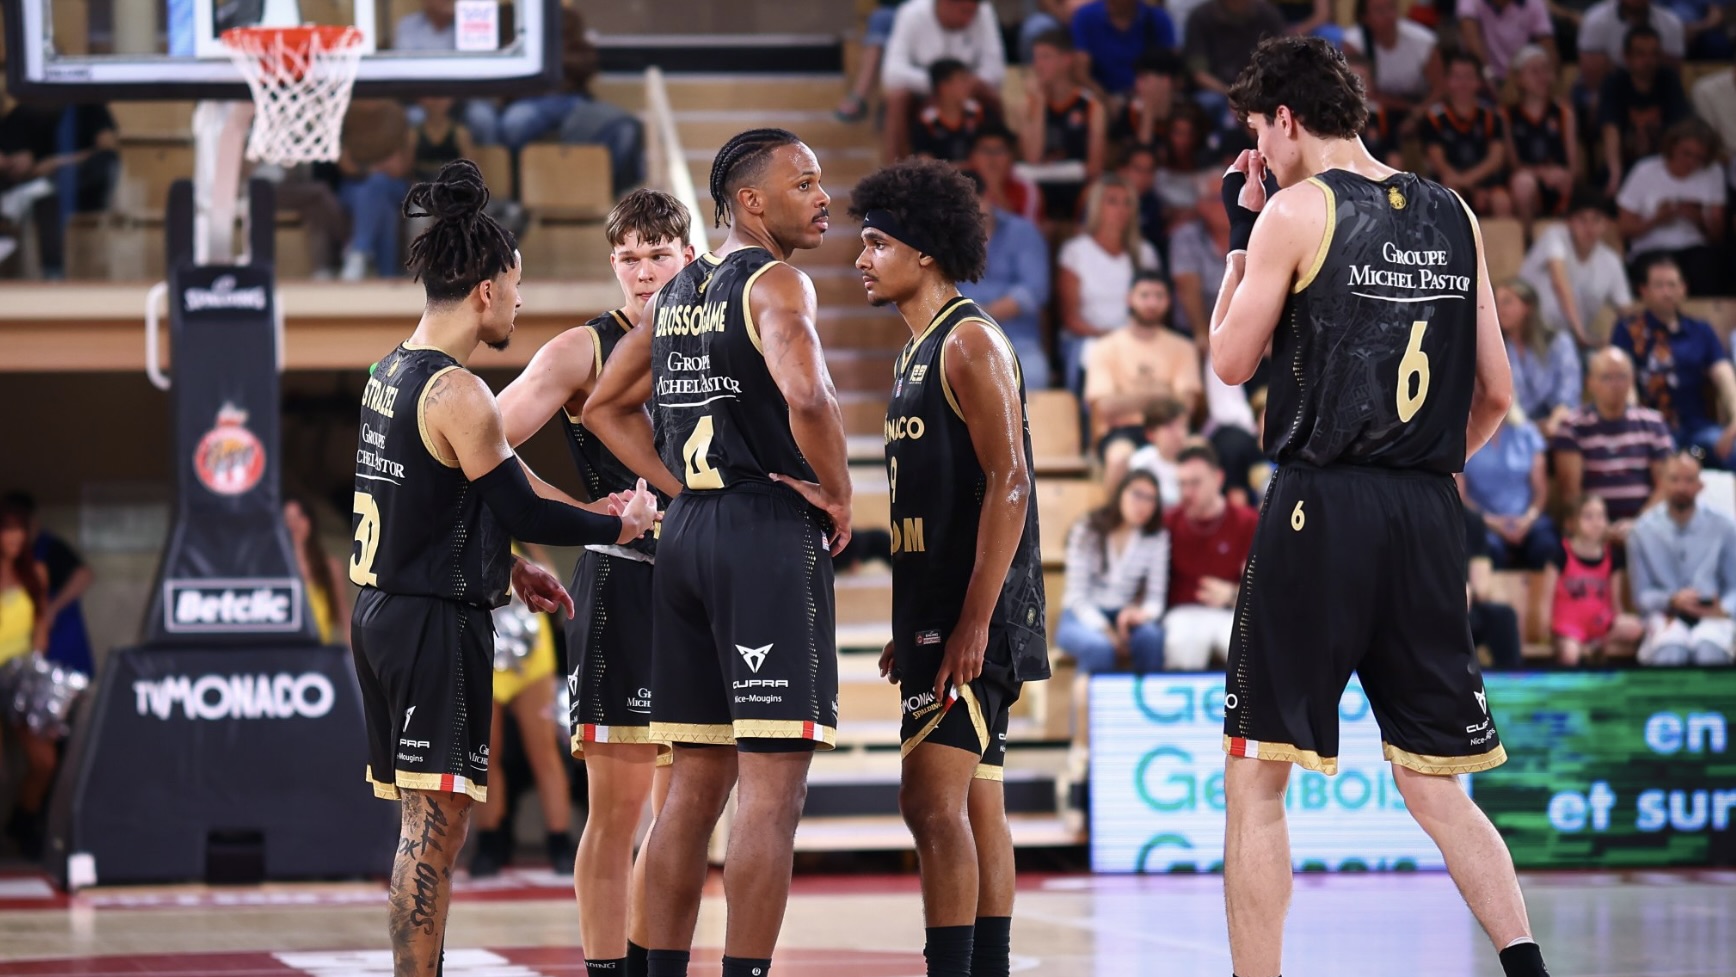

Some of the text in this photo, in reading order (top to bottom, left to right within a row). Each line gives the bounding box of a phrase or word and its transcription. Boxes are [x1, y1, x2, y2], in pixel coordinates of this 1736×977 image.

[1382, 241, 1448, 266] GROUPE
[1347, 264, 1470, 291] MICHEL PASTOR
[1396, 320, 1430, 423] 6
[362, 377, 399, 419] STRAZEL
[683, 415, 725, 490] 4
[1291, 500, 1305, 531] 6
[349, 491, 380, 587] 32
[176, 588, 290, 624] Betclic
[733, 680, 789, 690] CUPRA
[735, 695, 782, 705] ice-Mougins
[626, 697, 652, 708] MICH
[399, 738, 430, 749] PRA
[1645, 712, 1727, 752] en
[1548, 781, 1736, 832] et sur
